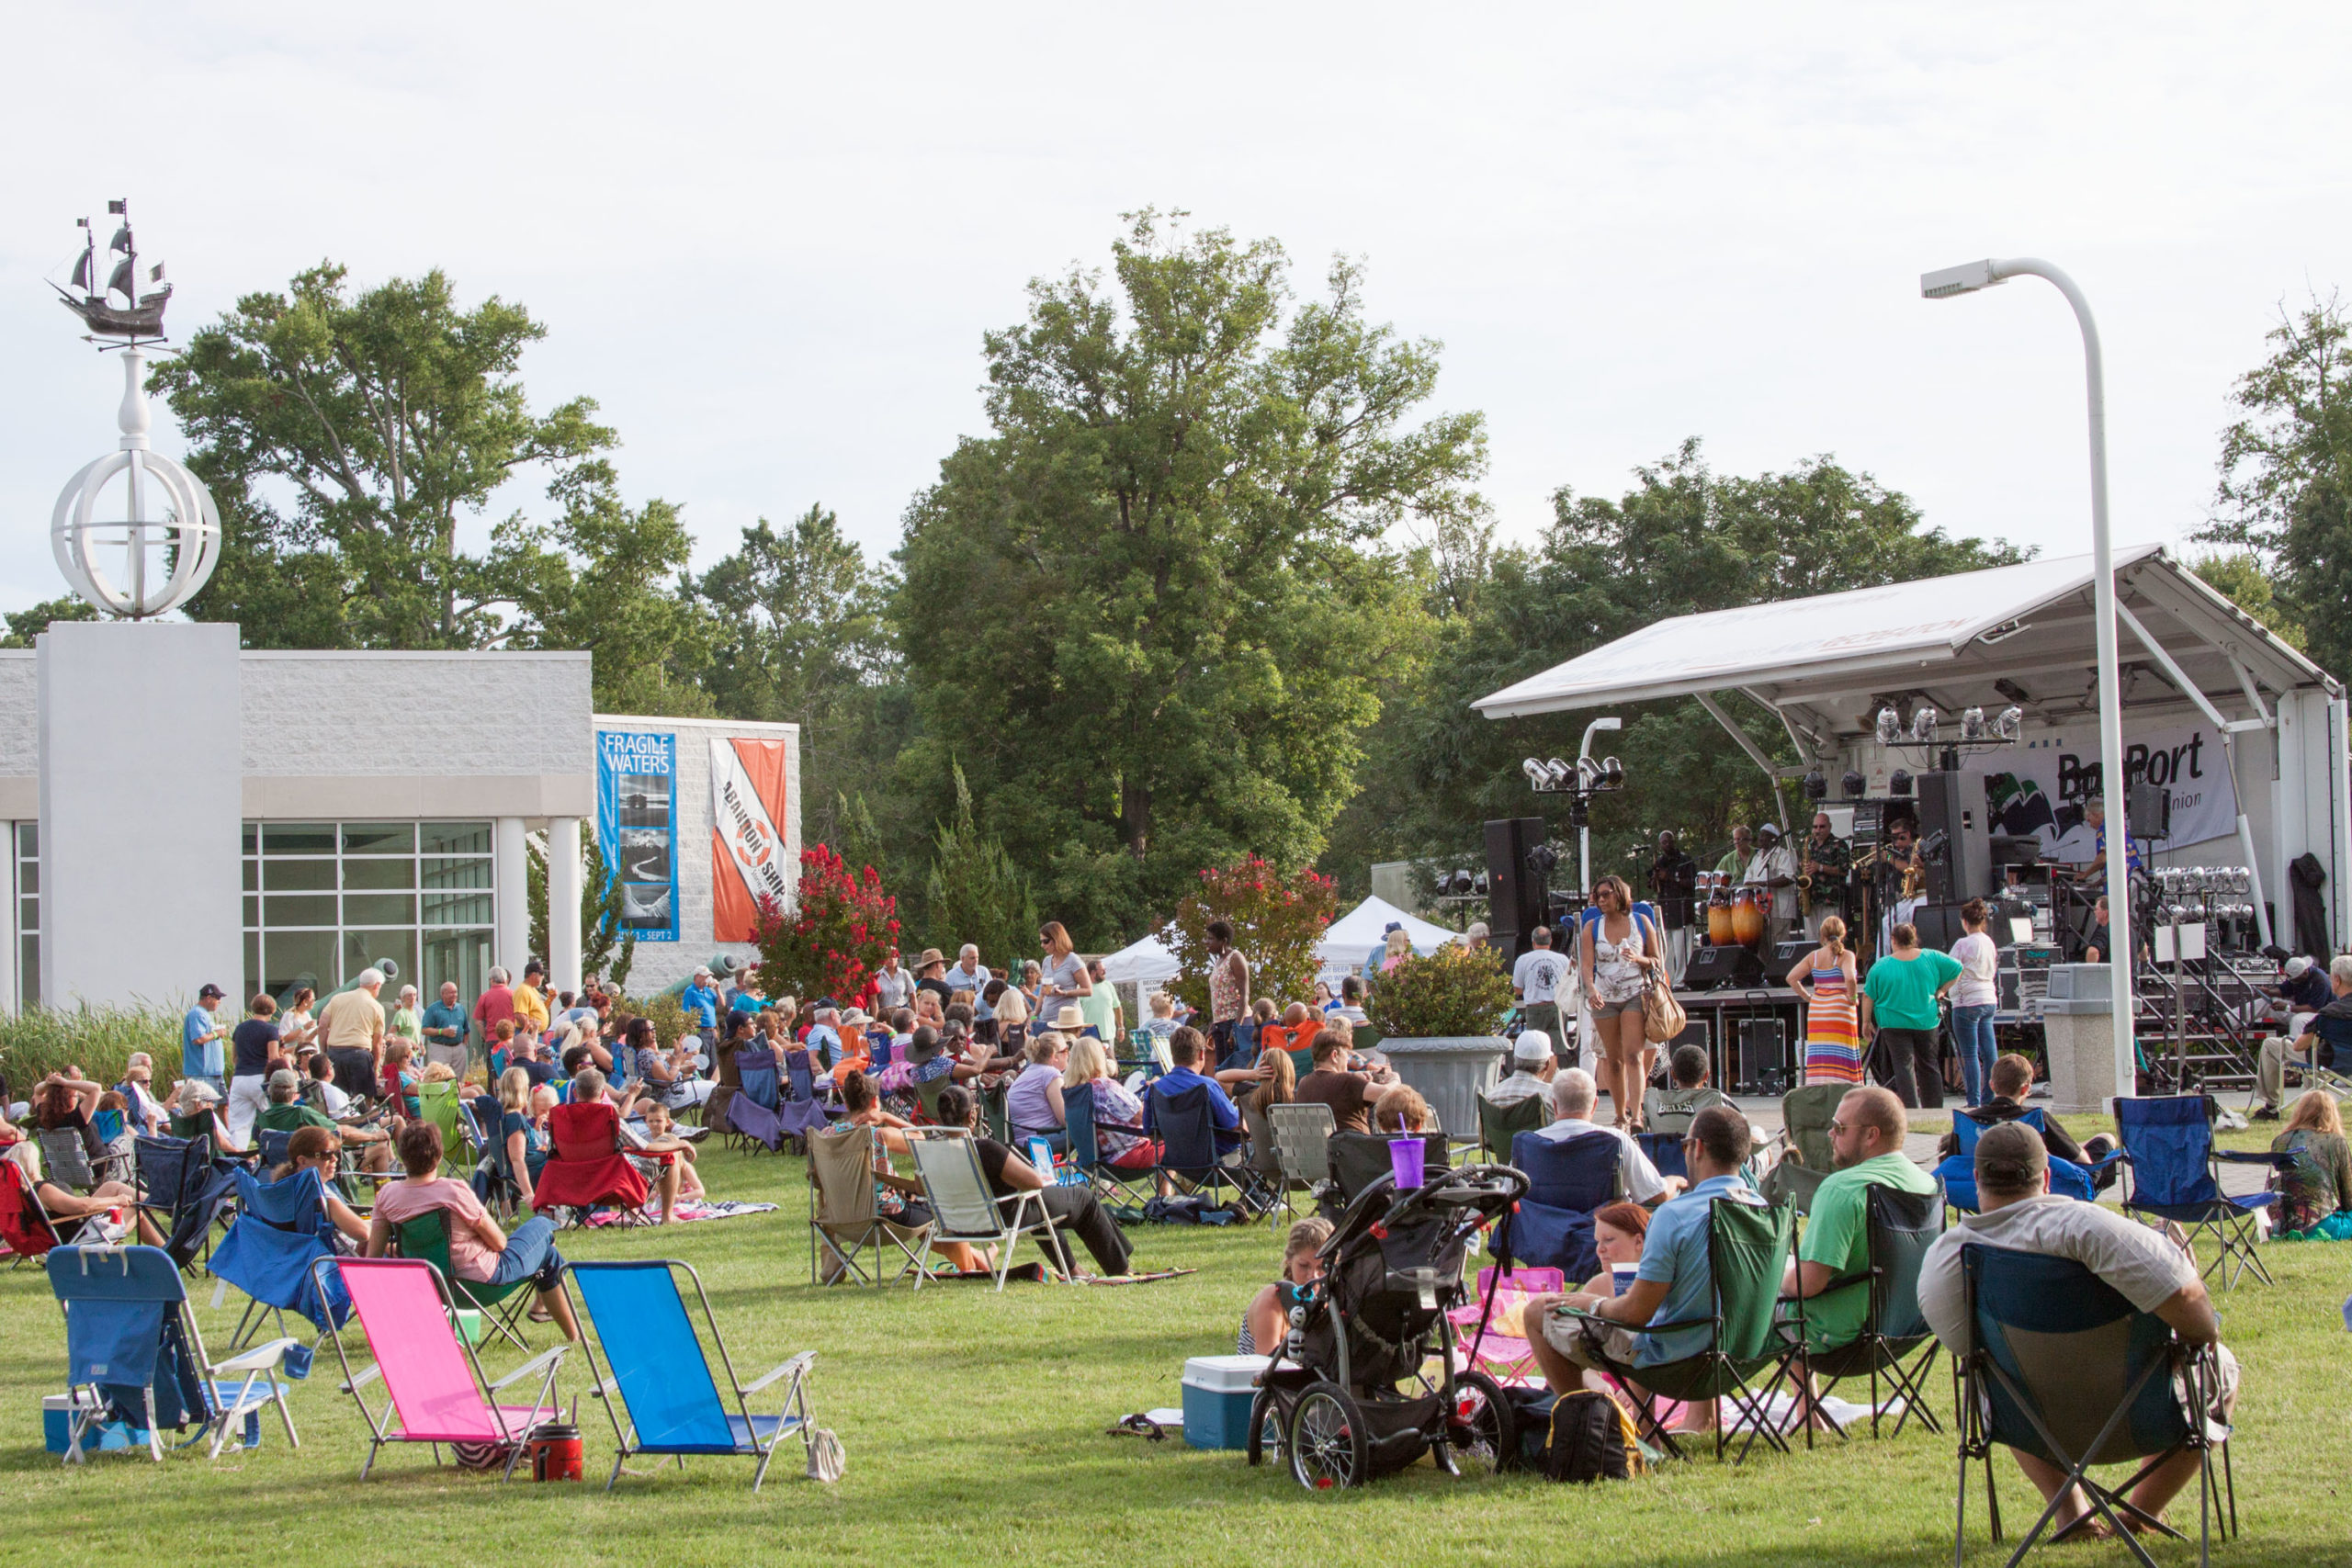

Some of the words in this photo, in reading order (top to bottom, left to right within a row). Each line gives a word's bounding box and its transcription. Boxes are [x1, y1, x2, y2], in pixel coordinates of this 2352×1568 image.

[605, 734, 669, 754] FRAGILE
[607, 753, 670, 773] WATERS
[2058, 732, 2203, 801] BaPort
[2171, 791, 2202, 811] nion
[723, 780, 763, 854] ABANDON
[762, 862, 786, 897] SHIP
[635, 931, 640, 941] 1
[646, 931, 665, 941] SEPT
[666, 931, 673, 940] 2
